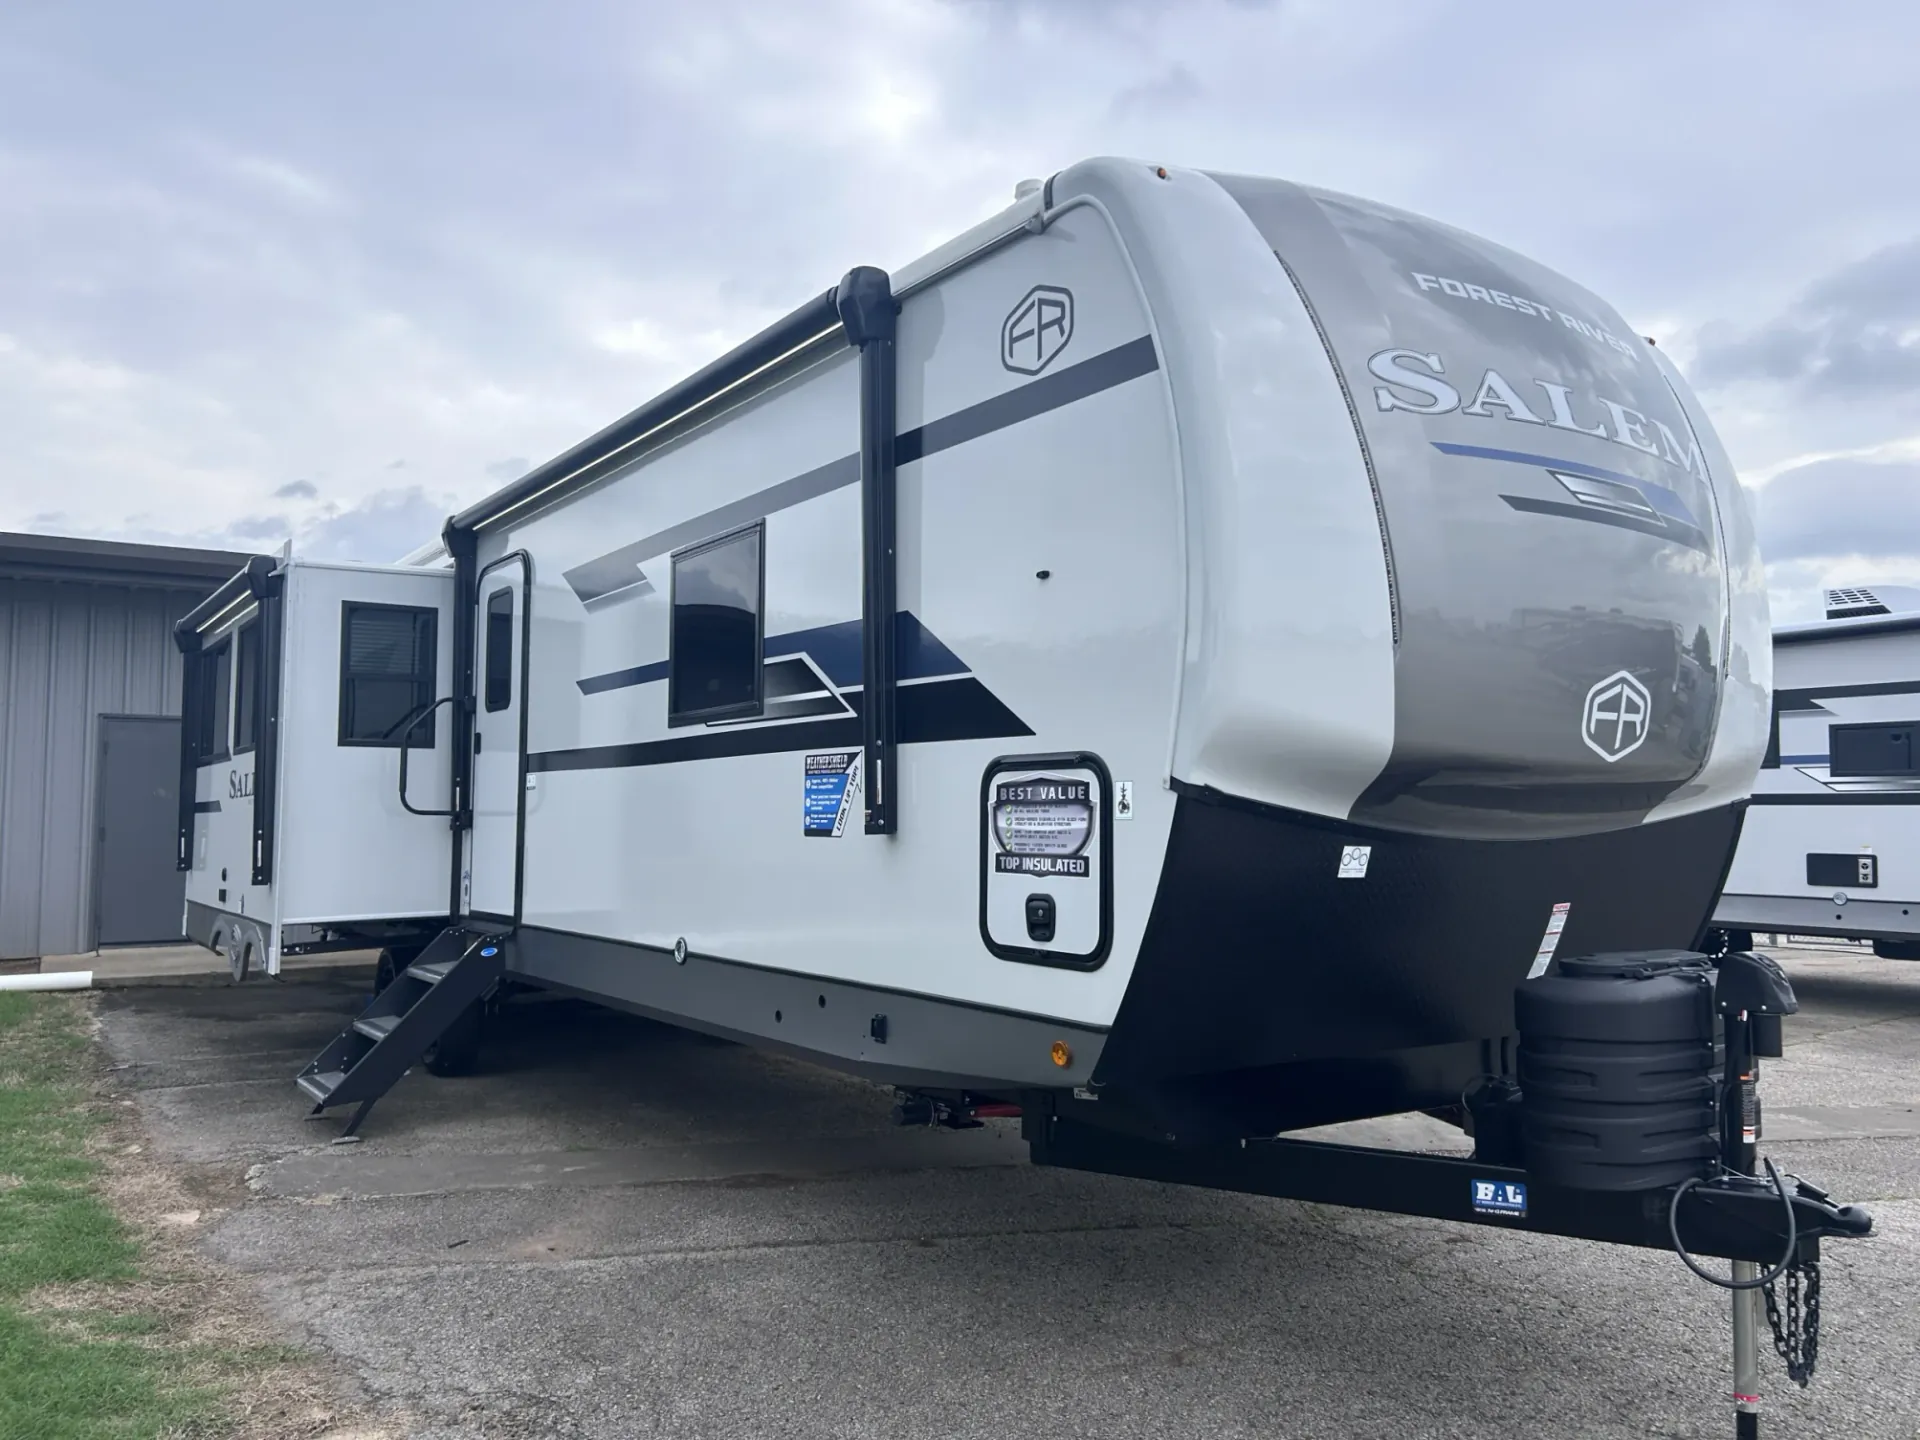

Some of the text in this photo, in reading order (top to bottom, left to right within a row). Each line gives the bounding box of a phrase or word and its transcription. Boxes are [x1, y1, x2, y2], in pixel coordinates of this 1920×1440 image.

[1411, 272, 1640, 362] FOREST RIVER
[1367, 348, 1709, 484] SALEM
[836, 807, 847, 831] LOOK
[844, 789, 851, 804] UP
[1000, 786, 1085, 801] BEST VALUE
[1000, 856, 1085, 873] TOP INSULATED
